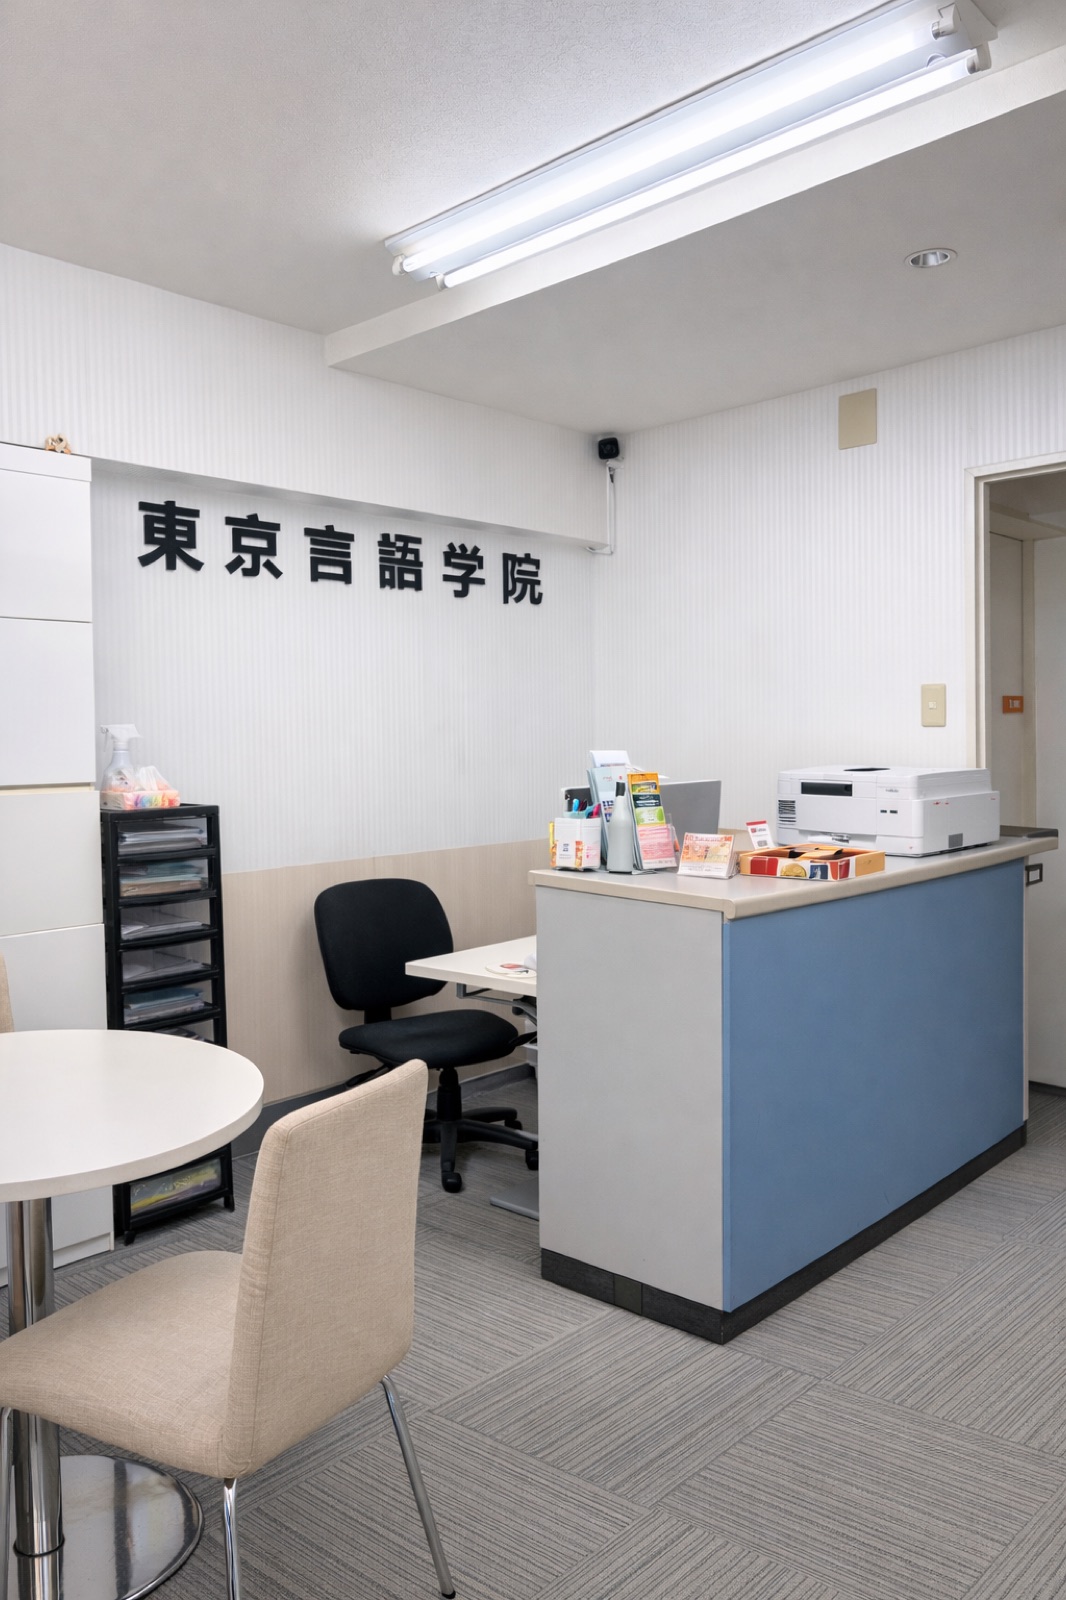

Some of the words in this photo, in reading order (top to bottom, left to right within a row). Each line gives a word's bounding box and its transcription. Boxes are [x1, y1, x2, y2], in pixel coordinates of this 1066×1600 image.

[138, 501, 543, 605] 東京言語学院
